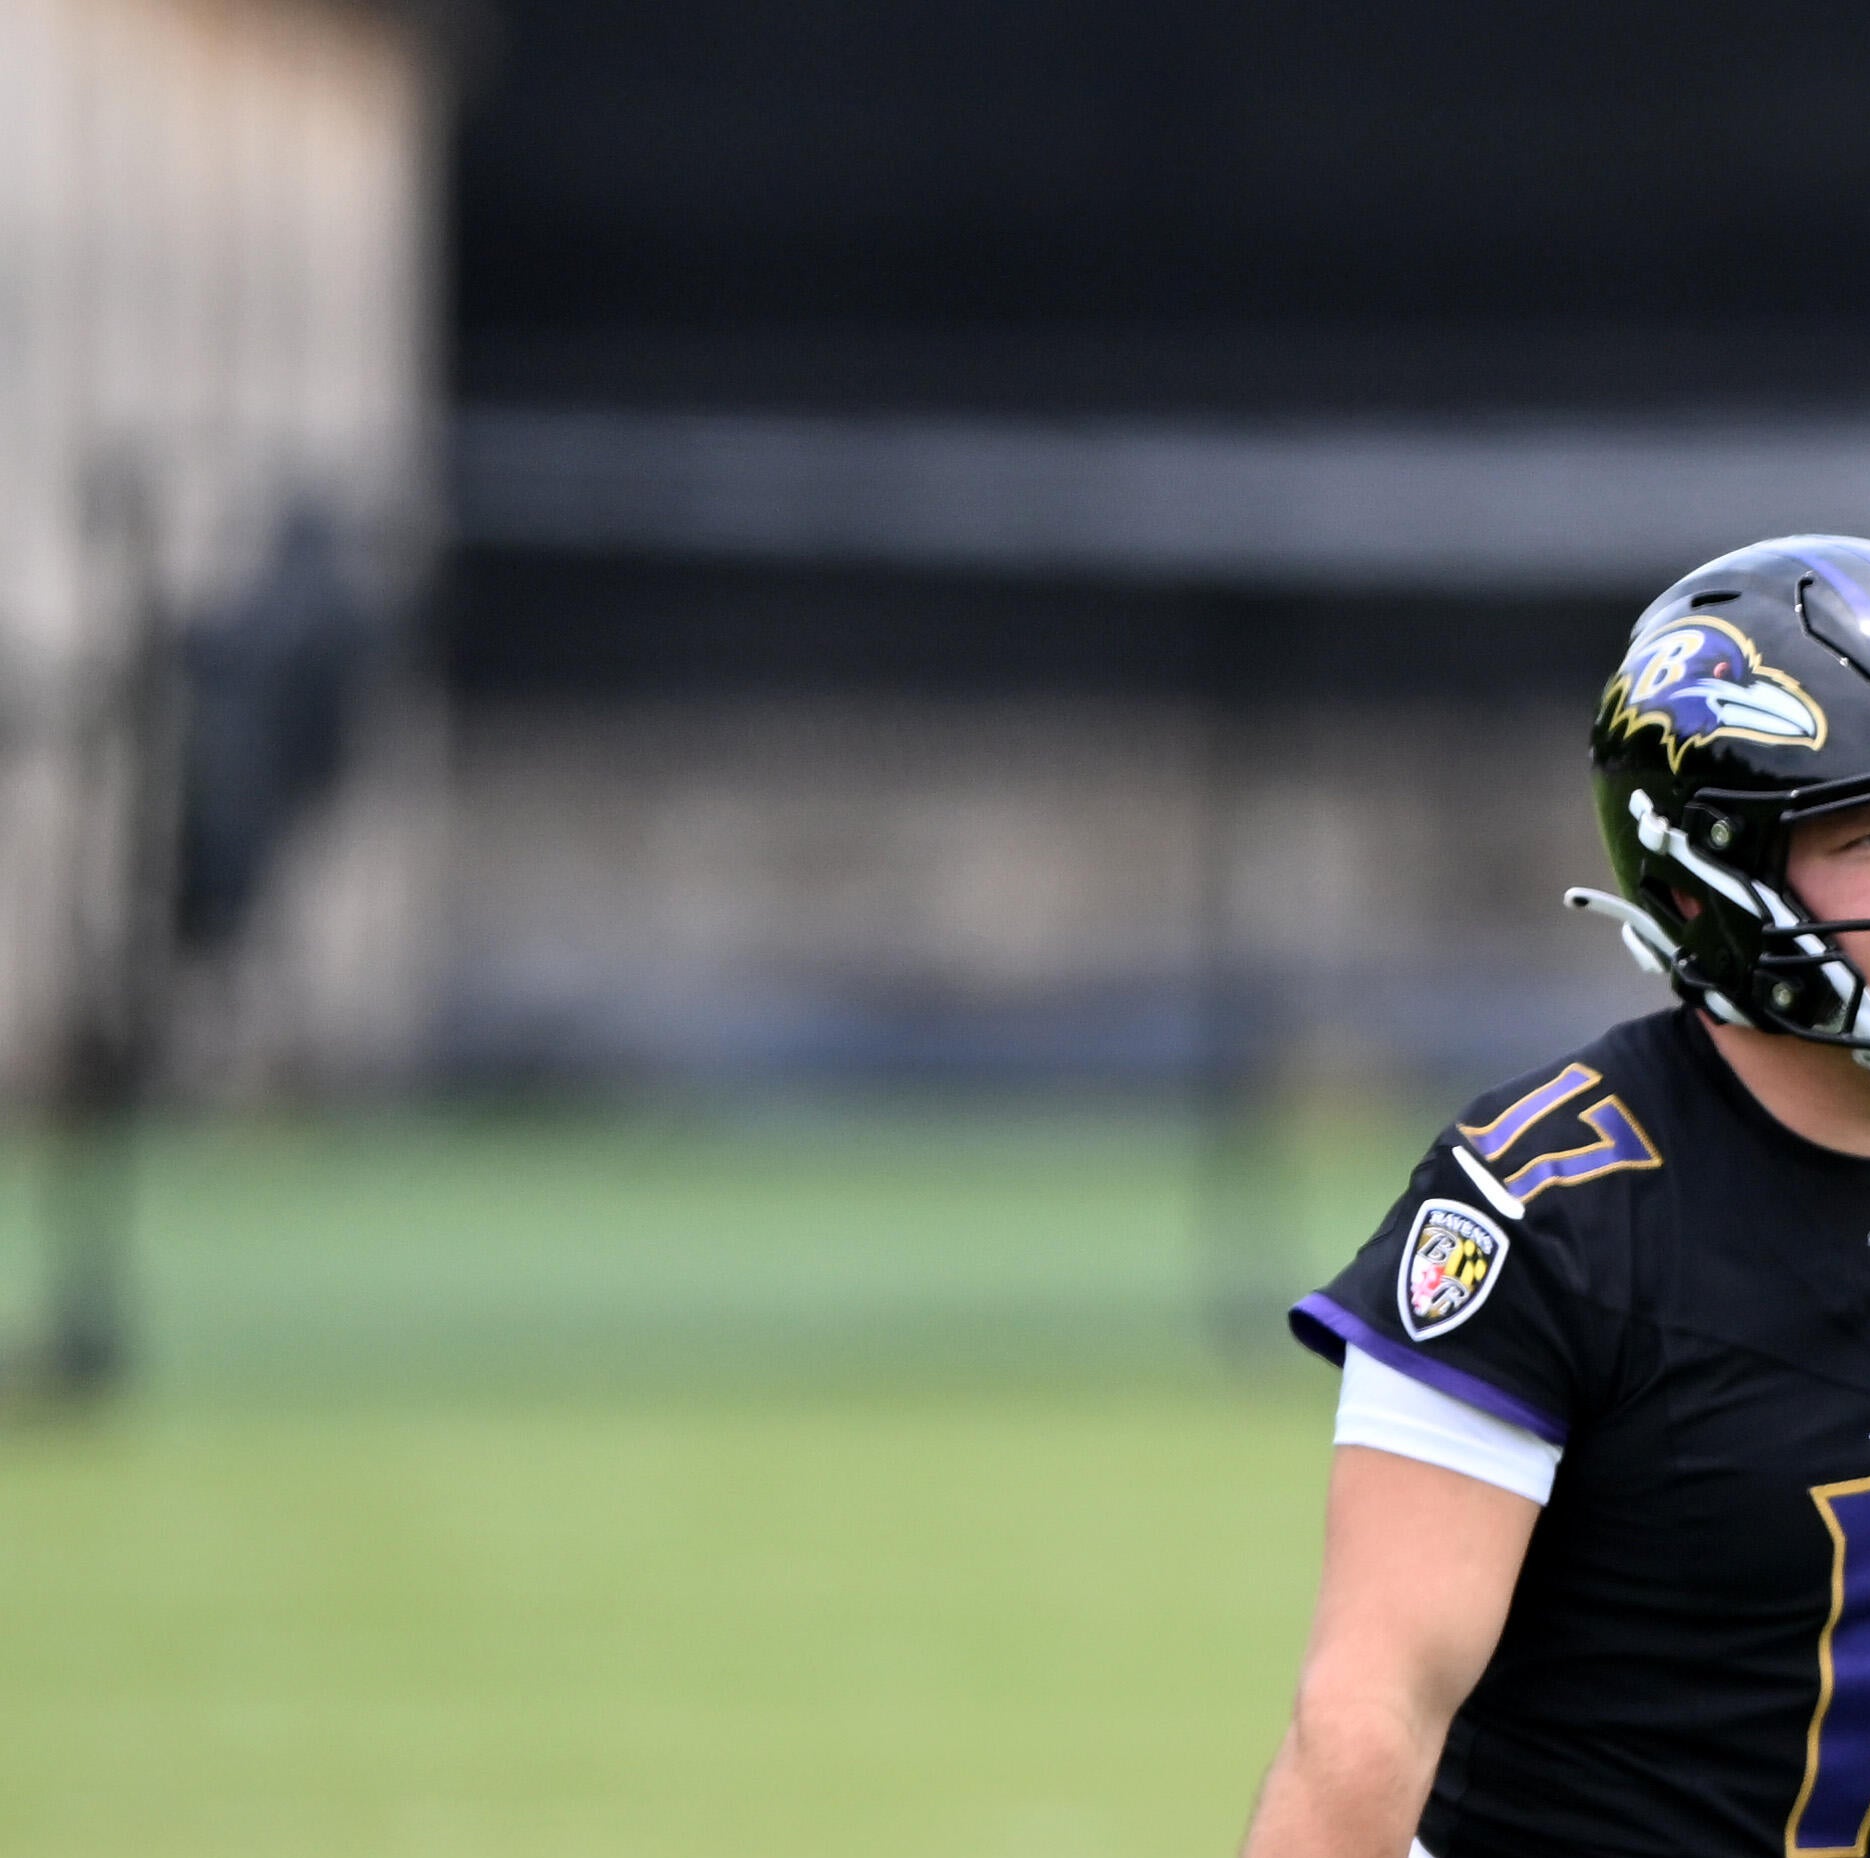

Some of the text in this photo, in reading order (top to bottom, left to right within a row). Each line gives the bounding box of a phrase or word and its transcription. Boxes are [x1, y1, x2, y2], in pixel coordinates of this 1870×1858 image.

[1629, 629, 1705, 704] B
[1455, 1062, 1664, 1205] 17
[1429, 1210, 1494, 1255] RAVENS
